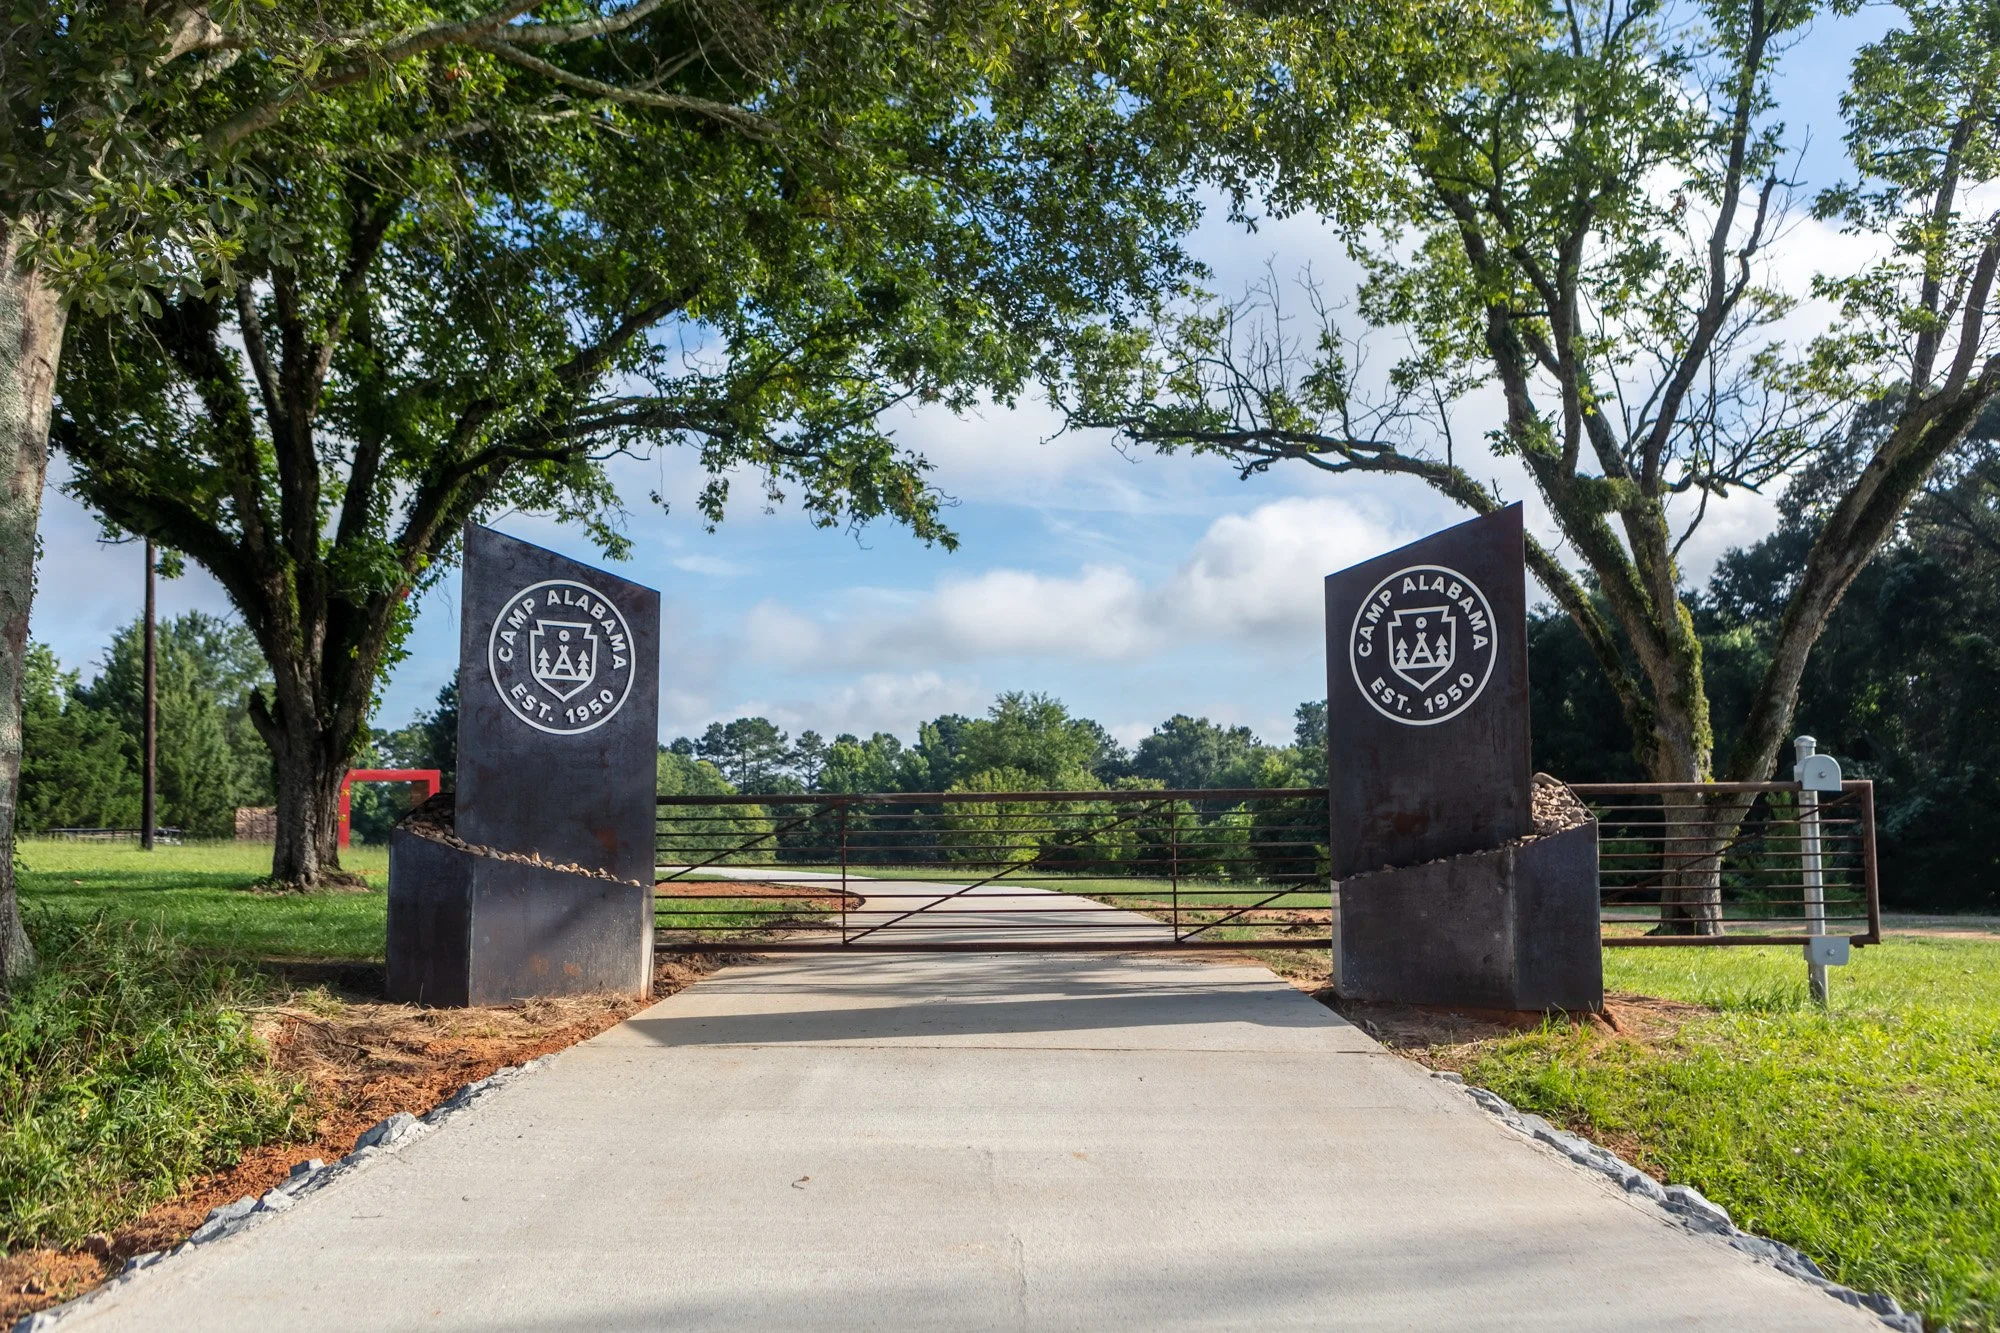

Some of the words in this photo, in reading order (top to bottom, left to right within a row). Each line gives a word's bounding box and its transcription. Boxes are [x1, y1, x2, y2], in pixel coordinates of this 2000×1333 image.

[498, 598, 535, 662] CAMP
[546, 590, 627, 669] ALABAMA
[1358, 589, 1392, 657] CAMP
[1402, 575, 1488, 650] ALABAMA
[510, 683, 553, 722] EST.
[565, 689, 613, 723] 1950
[1370, 677, 1412, 713] EST.
[1424, 673, 1474, 713] 1950
